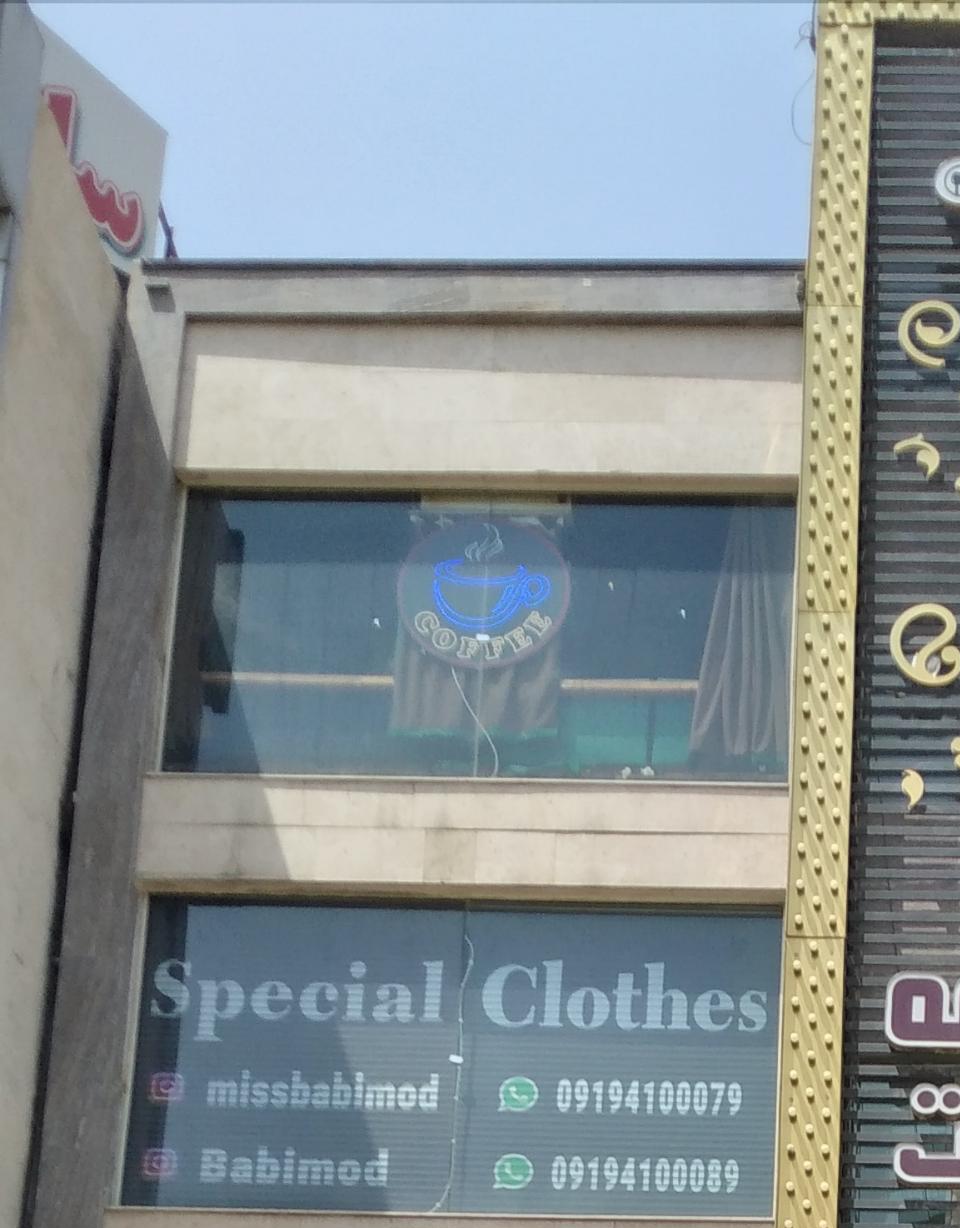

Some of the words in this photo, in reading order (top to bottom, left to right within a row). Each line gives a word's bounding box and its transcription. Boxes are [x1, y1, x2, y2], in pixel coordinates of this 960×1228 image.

[414, 611, 552, 660] COFFEE
[151, 958, 445, 1042] Special
[481, 958, 769, 1032] Clothes
[206, 1070, 440, 1112] missbabimod
[555, 1078, 743, 1116] 09194100079
[200, 1146, 389, 1187] Babimod
[551, 1155, 740, 1193] 09194100089
